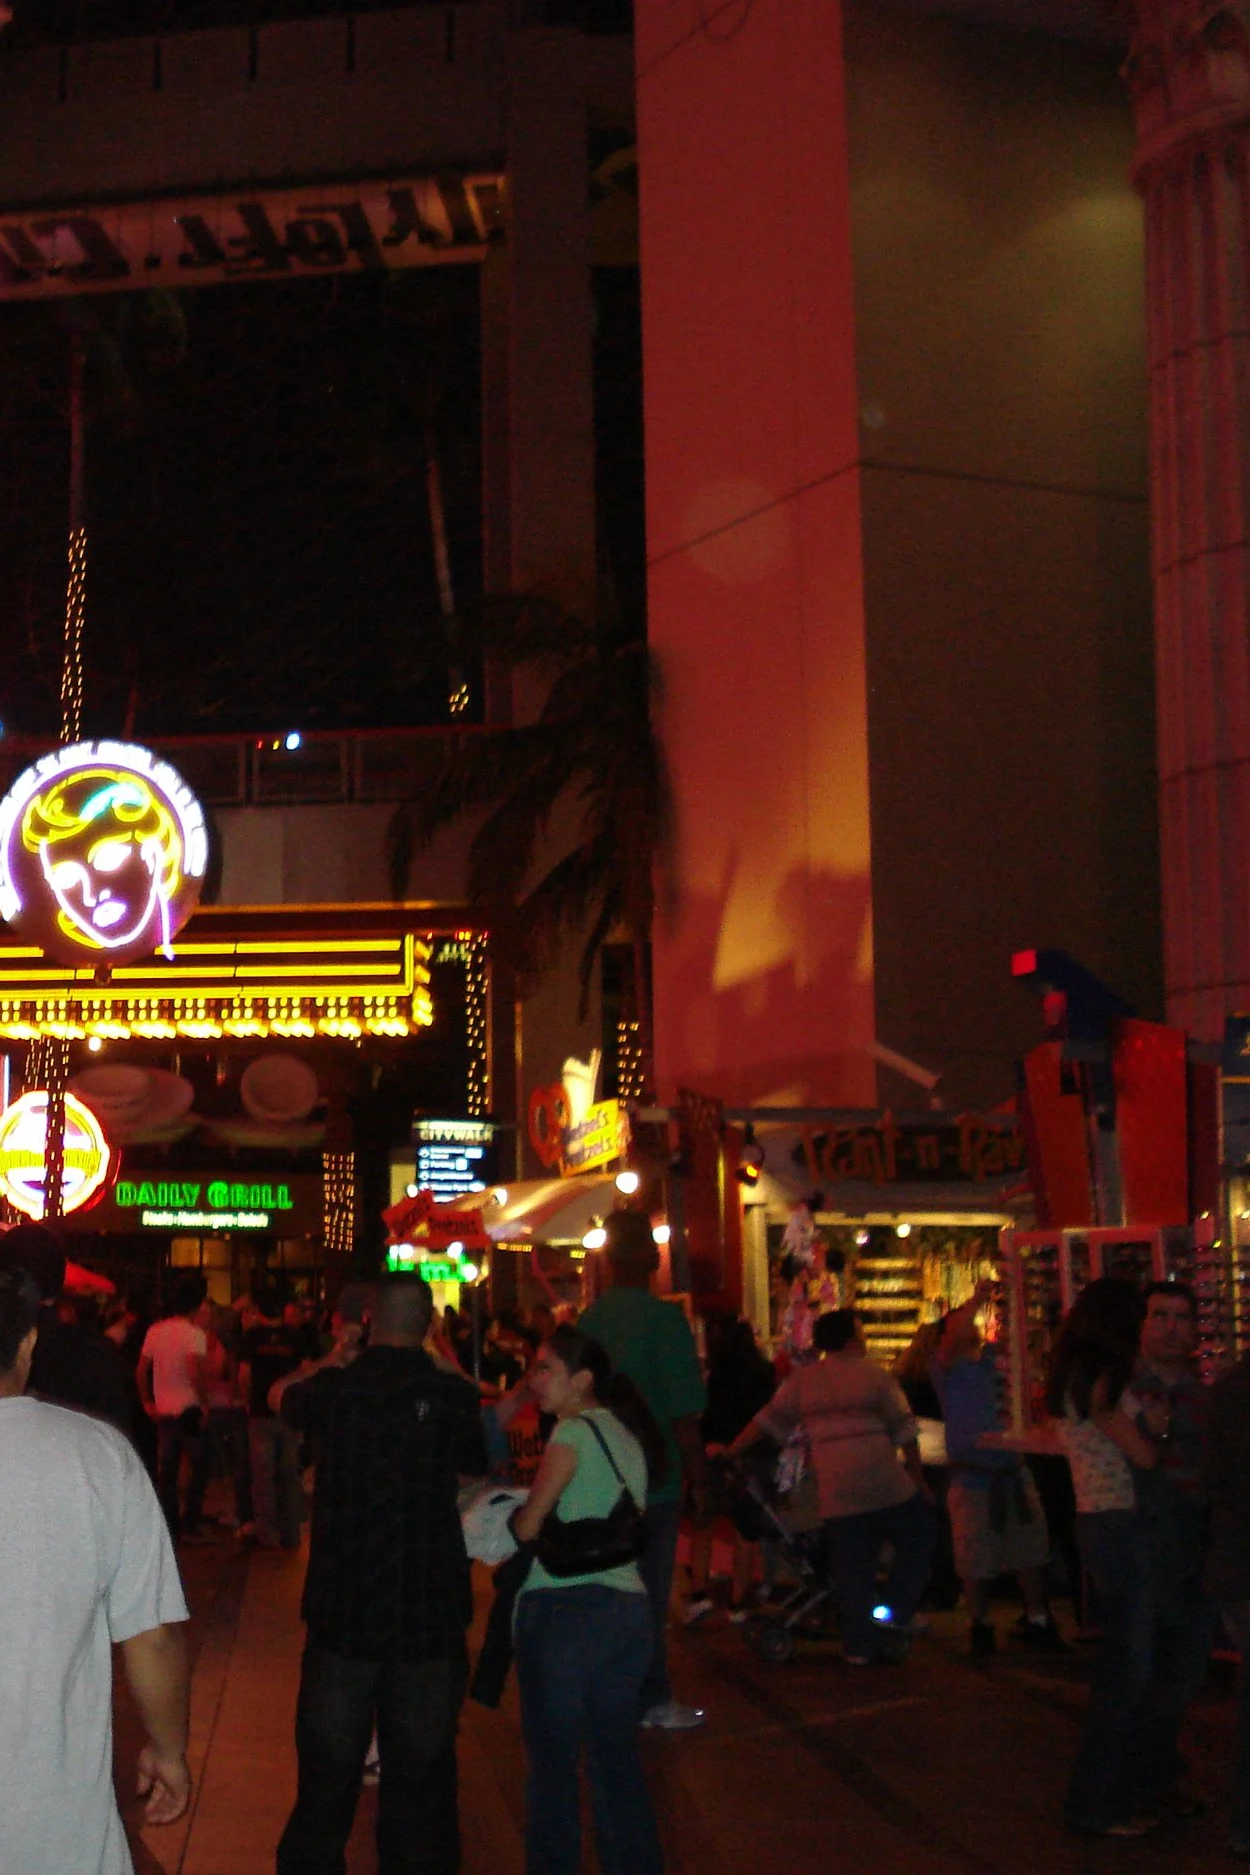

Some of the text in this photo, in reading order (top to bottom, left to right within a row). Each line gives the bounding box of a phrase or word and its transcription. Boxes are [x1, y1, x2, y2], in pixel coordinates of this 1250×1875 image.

[419, 1129, 494, 1142] CITYWALK
[115, 1180, 294, 1209] DAILY GRILL
